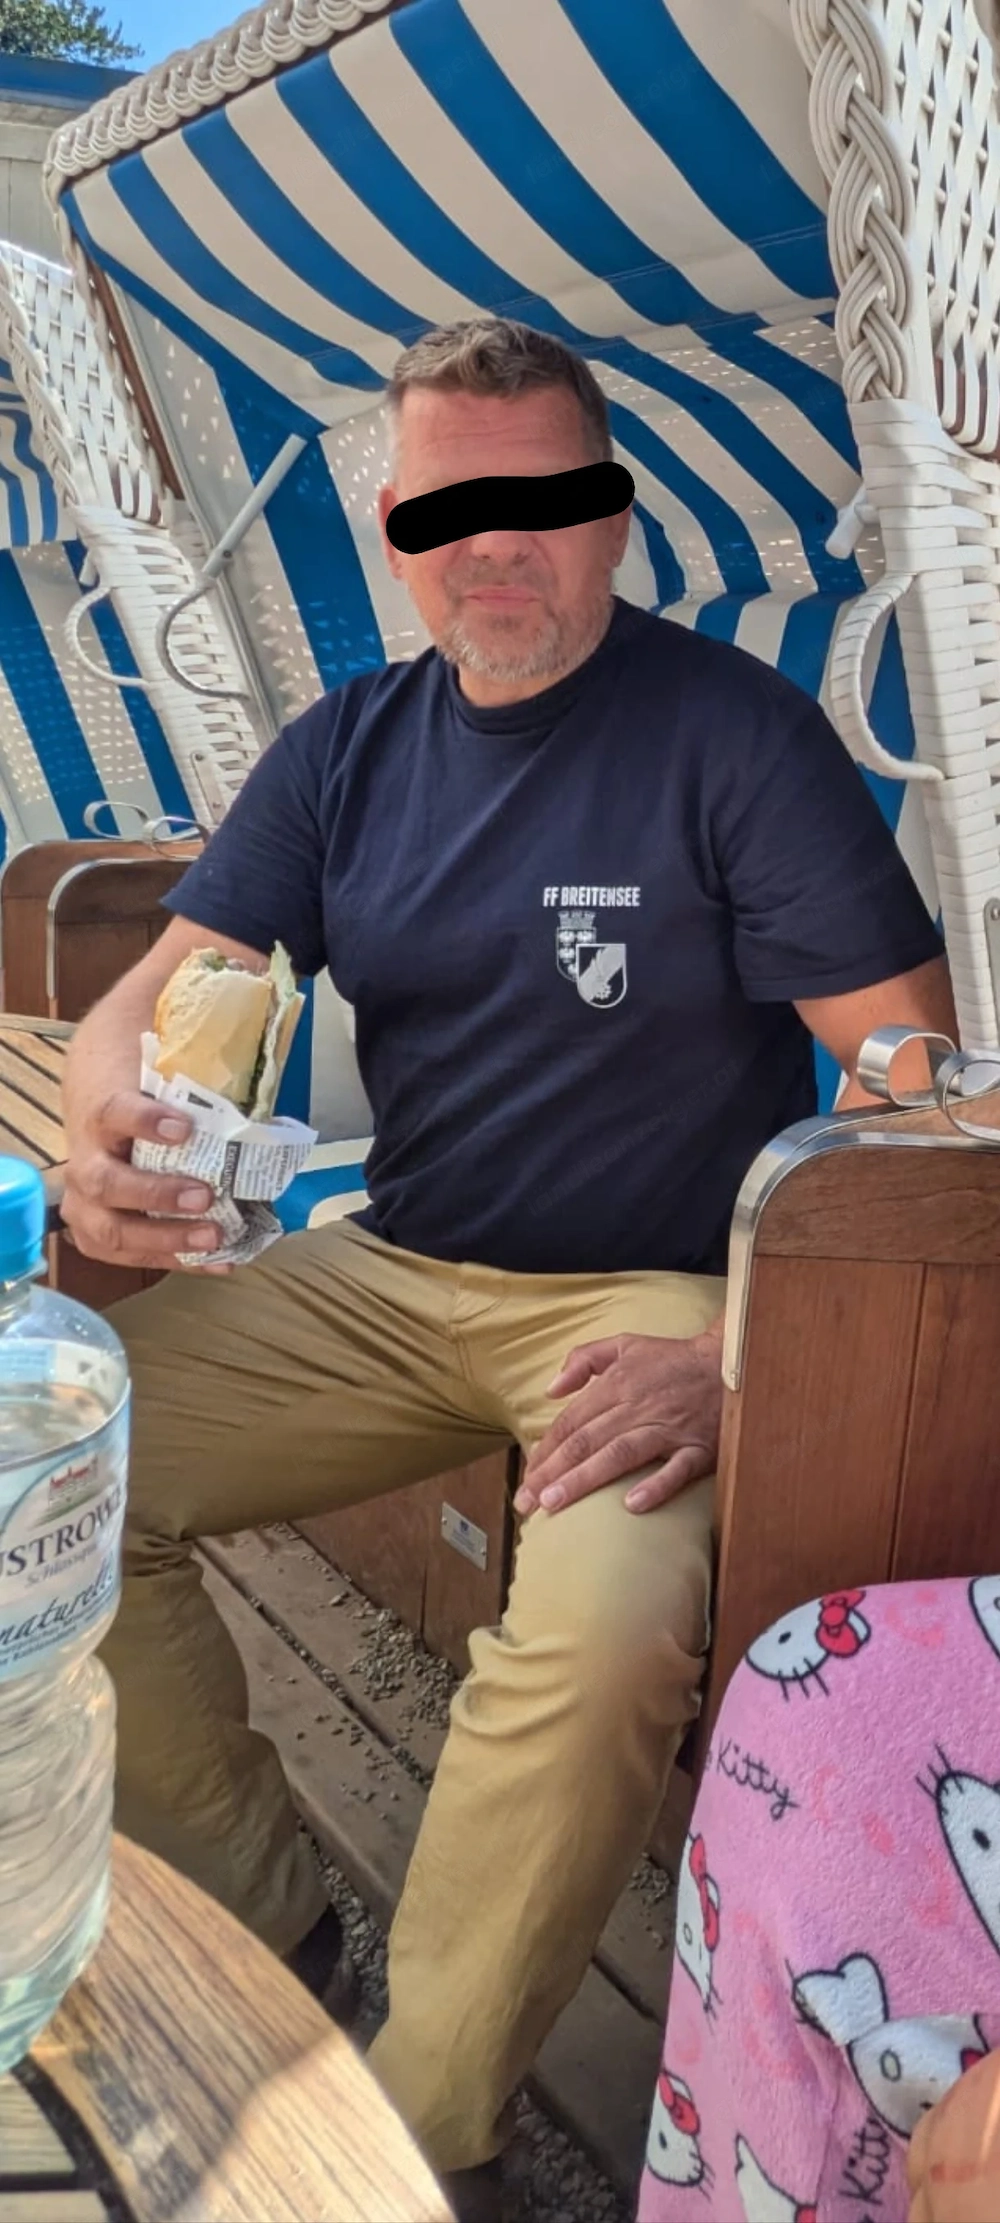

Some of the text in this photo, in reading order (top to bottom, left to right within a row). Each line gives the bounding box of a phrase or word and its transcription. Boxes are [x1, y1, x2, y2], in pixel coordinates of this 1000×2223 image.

[543, 886, 641, 907] FF BREITENSEE
[716, 1737, 801, 1821] Kitty
